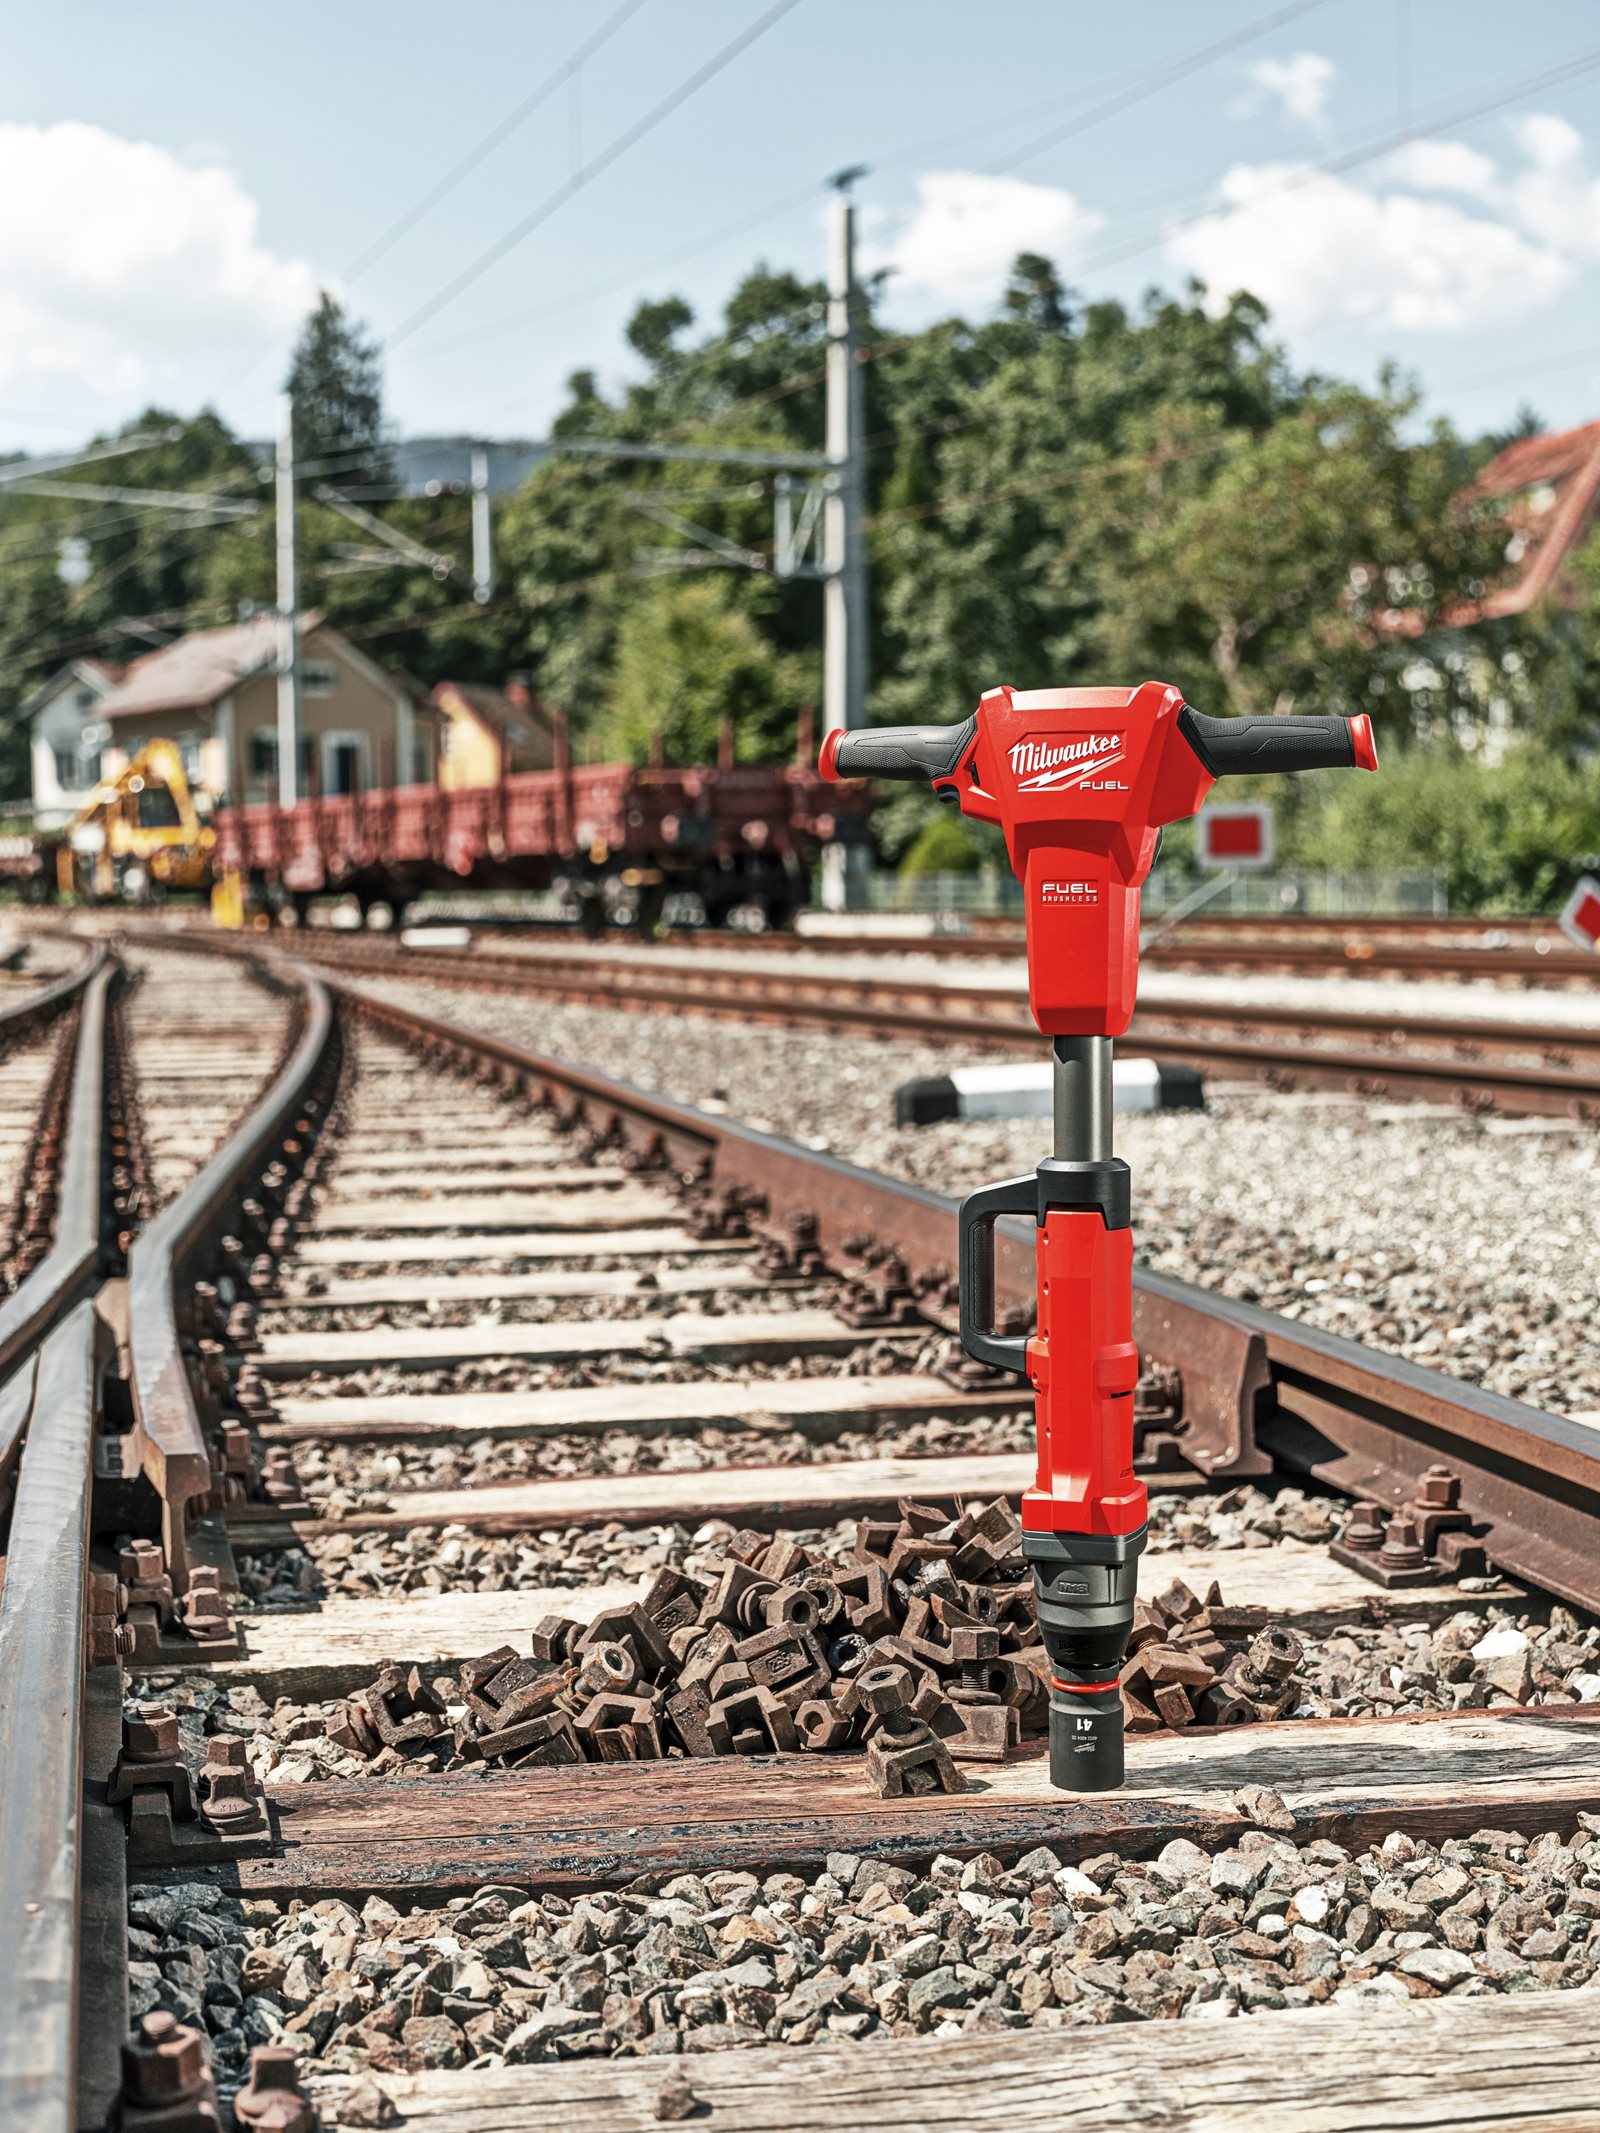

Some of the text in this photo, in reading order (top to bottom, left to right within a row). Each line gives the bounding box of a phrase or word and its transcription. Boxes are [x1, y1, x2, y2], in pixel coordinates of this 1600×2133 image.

[1007, 735, 1122, 776] Milwaukee
[1079, 781, 1129, 790] FUEL
[1042, 883, 1098, 893] FUEL
[1076, 1718, 1093, 1731] 41
